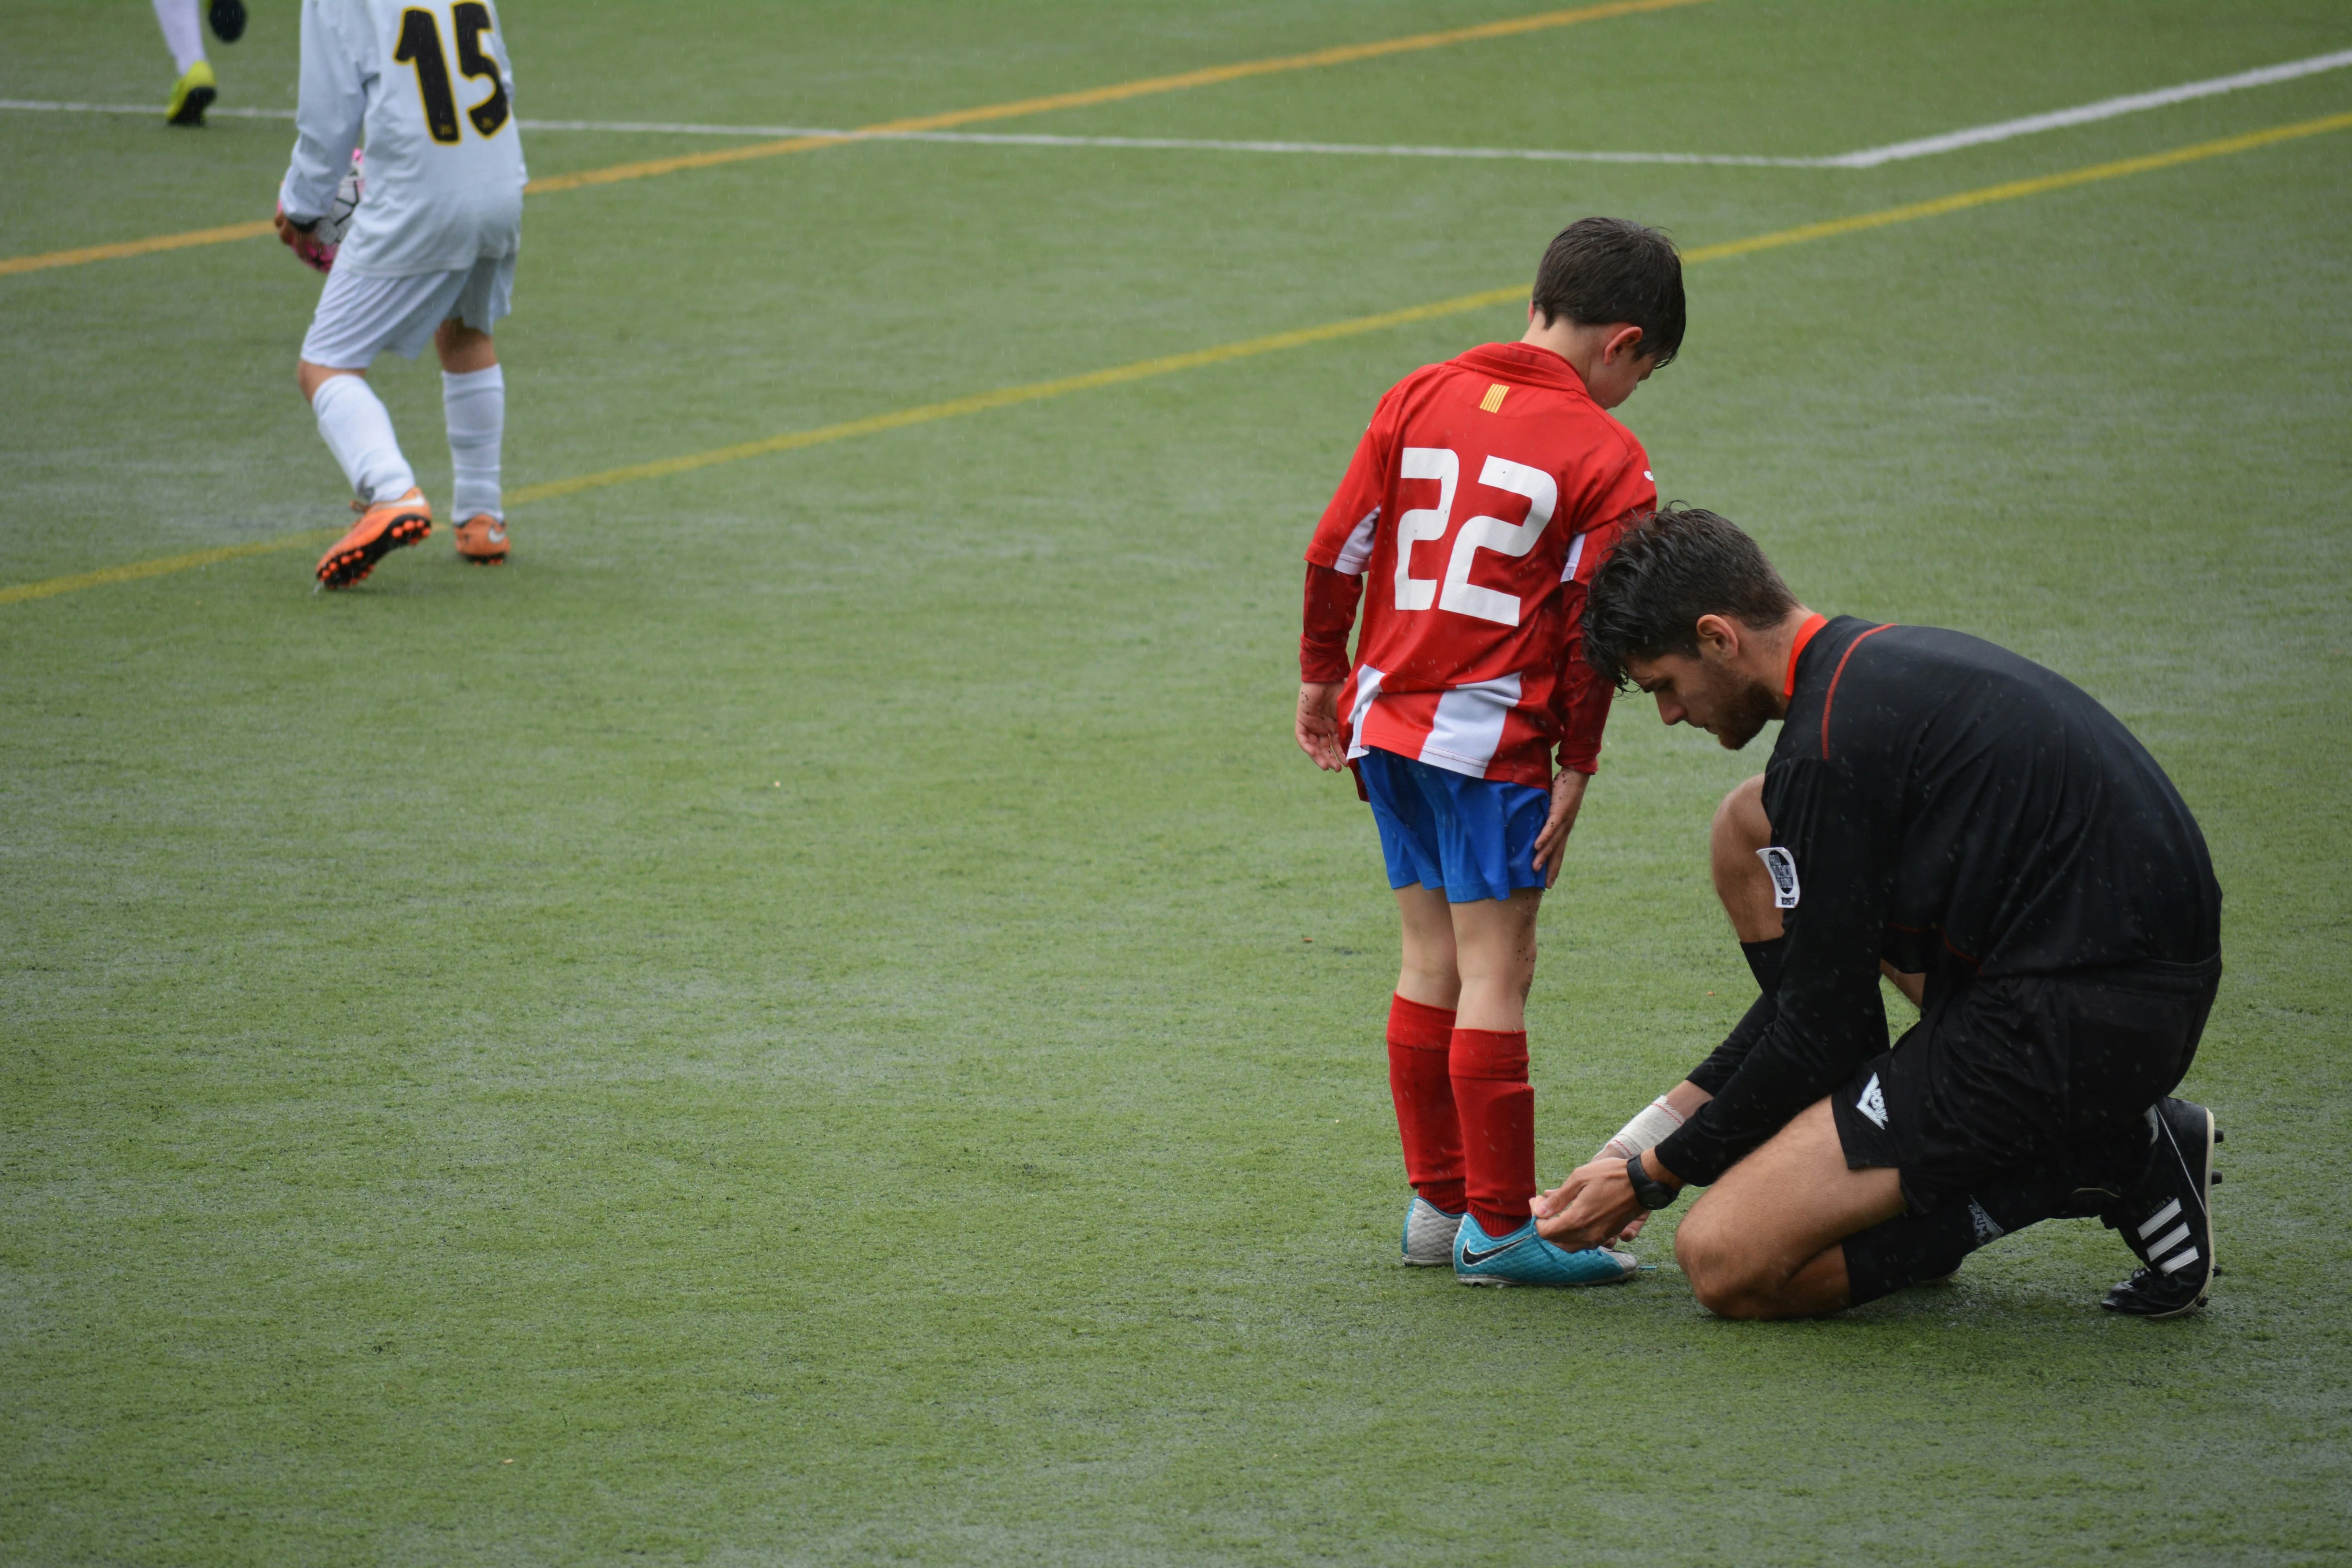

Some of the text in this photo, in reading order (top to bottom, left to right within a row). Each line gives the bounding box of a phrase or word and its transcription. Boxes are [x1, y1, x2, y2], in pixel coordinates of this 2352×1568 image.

[393, 0, 510, 146] 15
[1394, 448, 1558, 627] 22
[1870, 1089, 1888, 1122] PONY
